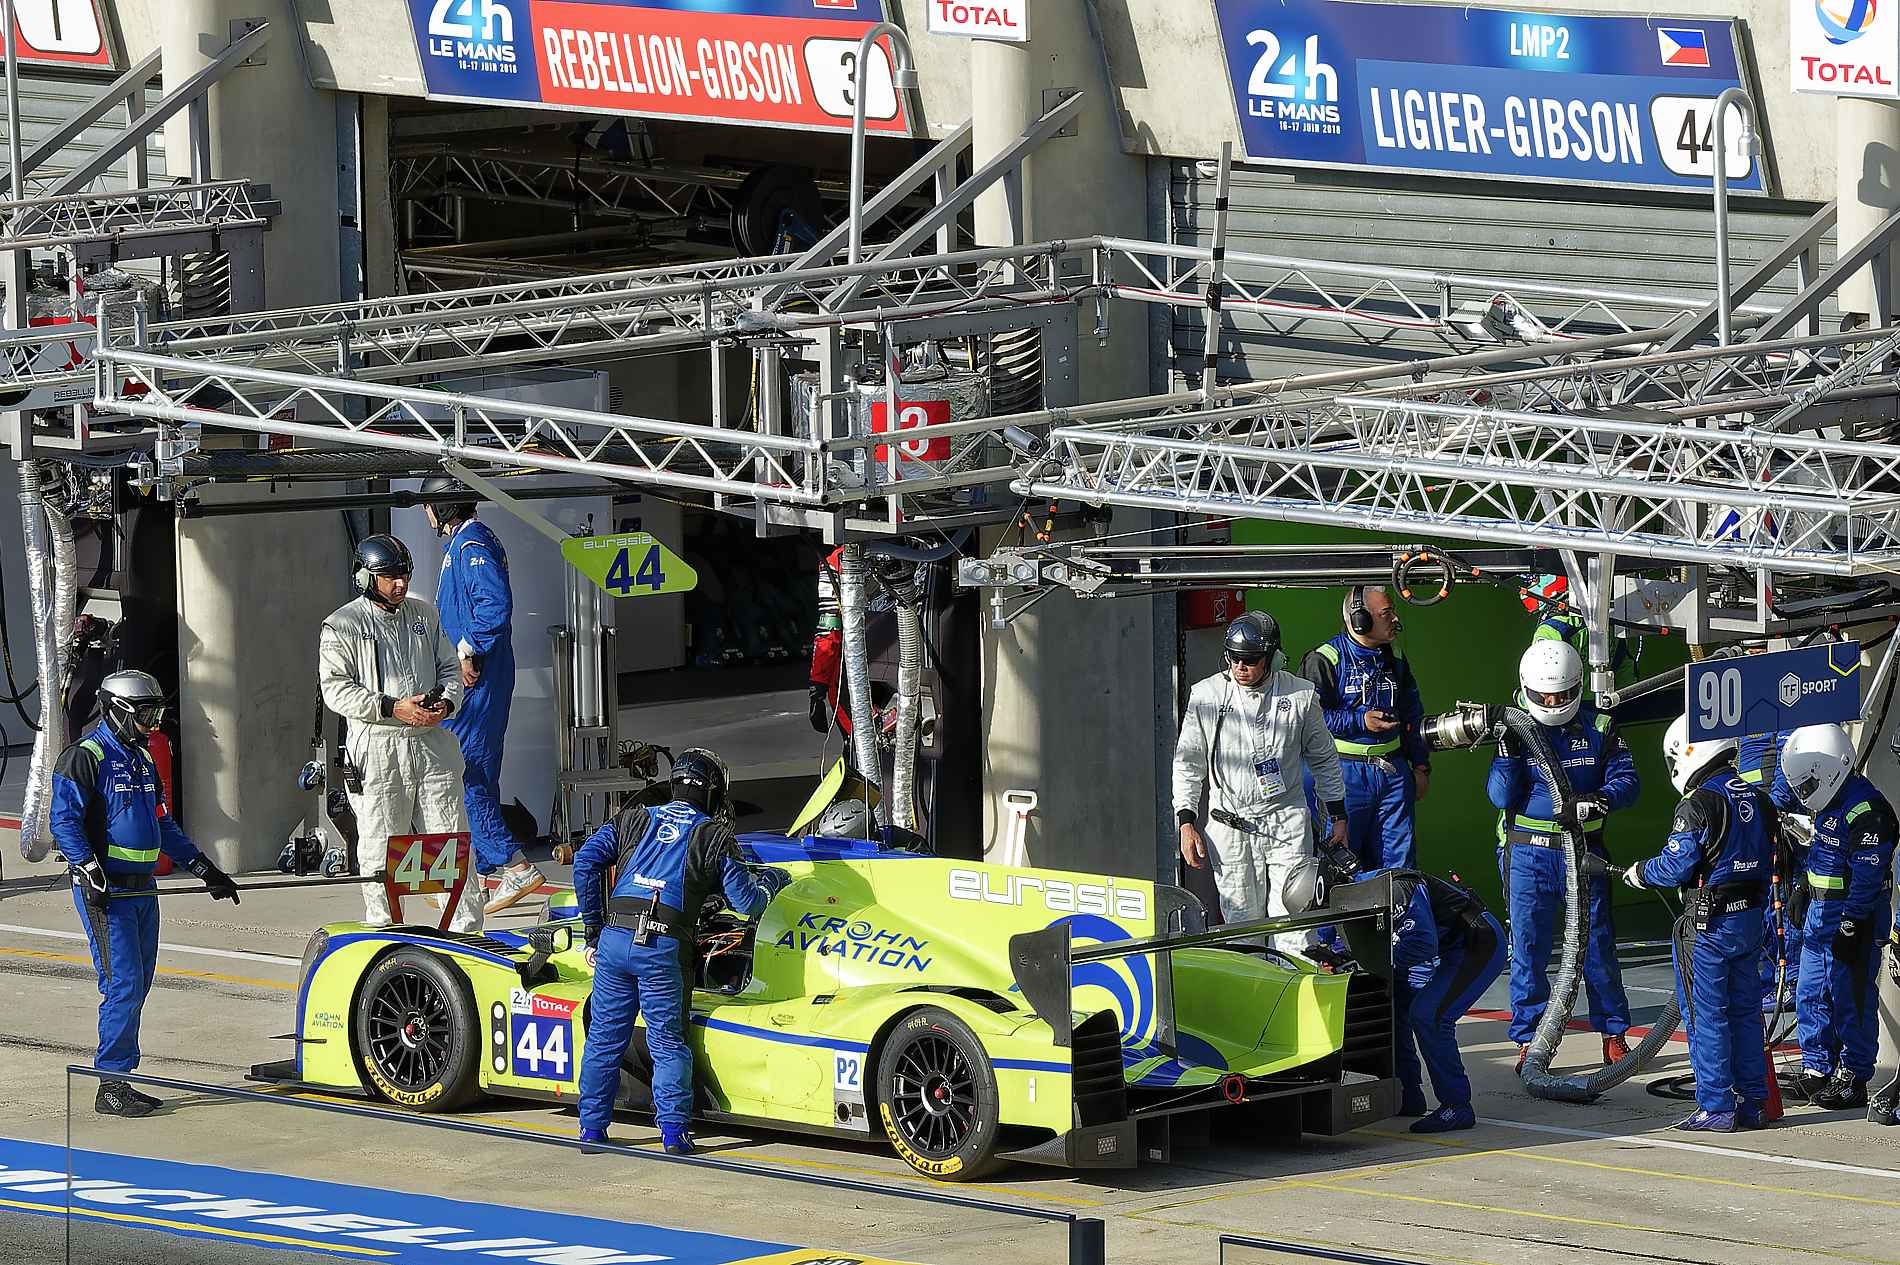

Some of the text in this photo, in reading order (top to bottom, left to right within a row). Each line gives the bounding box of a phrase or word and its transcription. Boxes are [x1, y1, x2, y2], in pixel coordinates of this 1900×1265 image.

[429, 38, 516, 63] LE MANS
[543, 26, 802, 105] REBELLION-GIBSON
[1246, 29, 1338, 102] 24h
[1509, 22, 1570, 60] LMP2
[840, 51, 857, 106] 3
[1249, 99, 1340, 124] LE MANS
[1279, 121, 1300, 132] 16-17
[1302, 122, 1320, 133] JUIN
[1370, 87, 1644, 166] LIGIER-GIBSON
[900, 406, 928, 458] 3
[583, 534, 654, 549] eurasia
[605, 544, 666, 594] 44
[1698, 667, 1742, 730] 90
[1783, 678, 1838, 699] TF SPORT
[394, 839, 460, 891] 44
[949, 868, 1148, 921] eurasia
[775, 928, 933, 973] AVIATION
[311, 1019, 345, 1030] AVIATION
[516, 1022, 569, 1075] 44
[837, 1057, 858, 1086] P2
